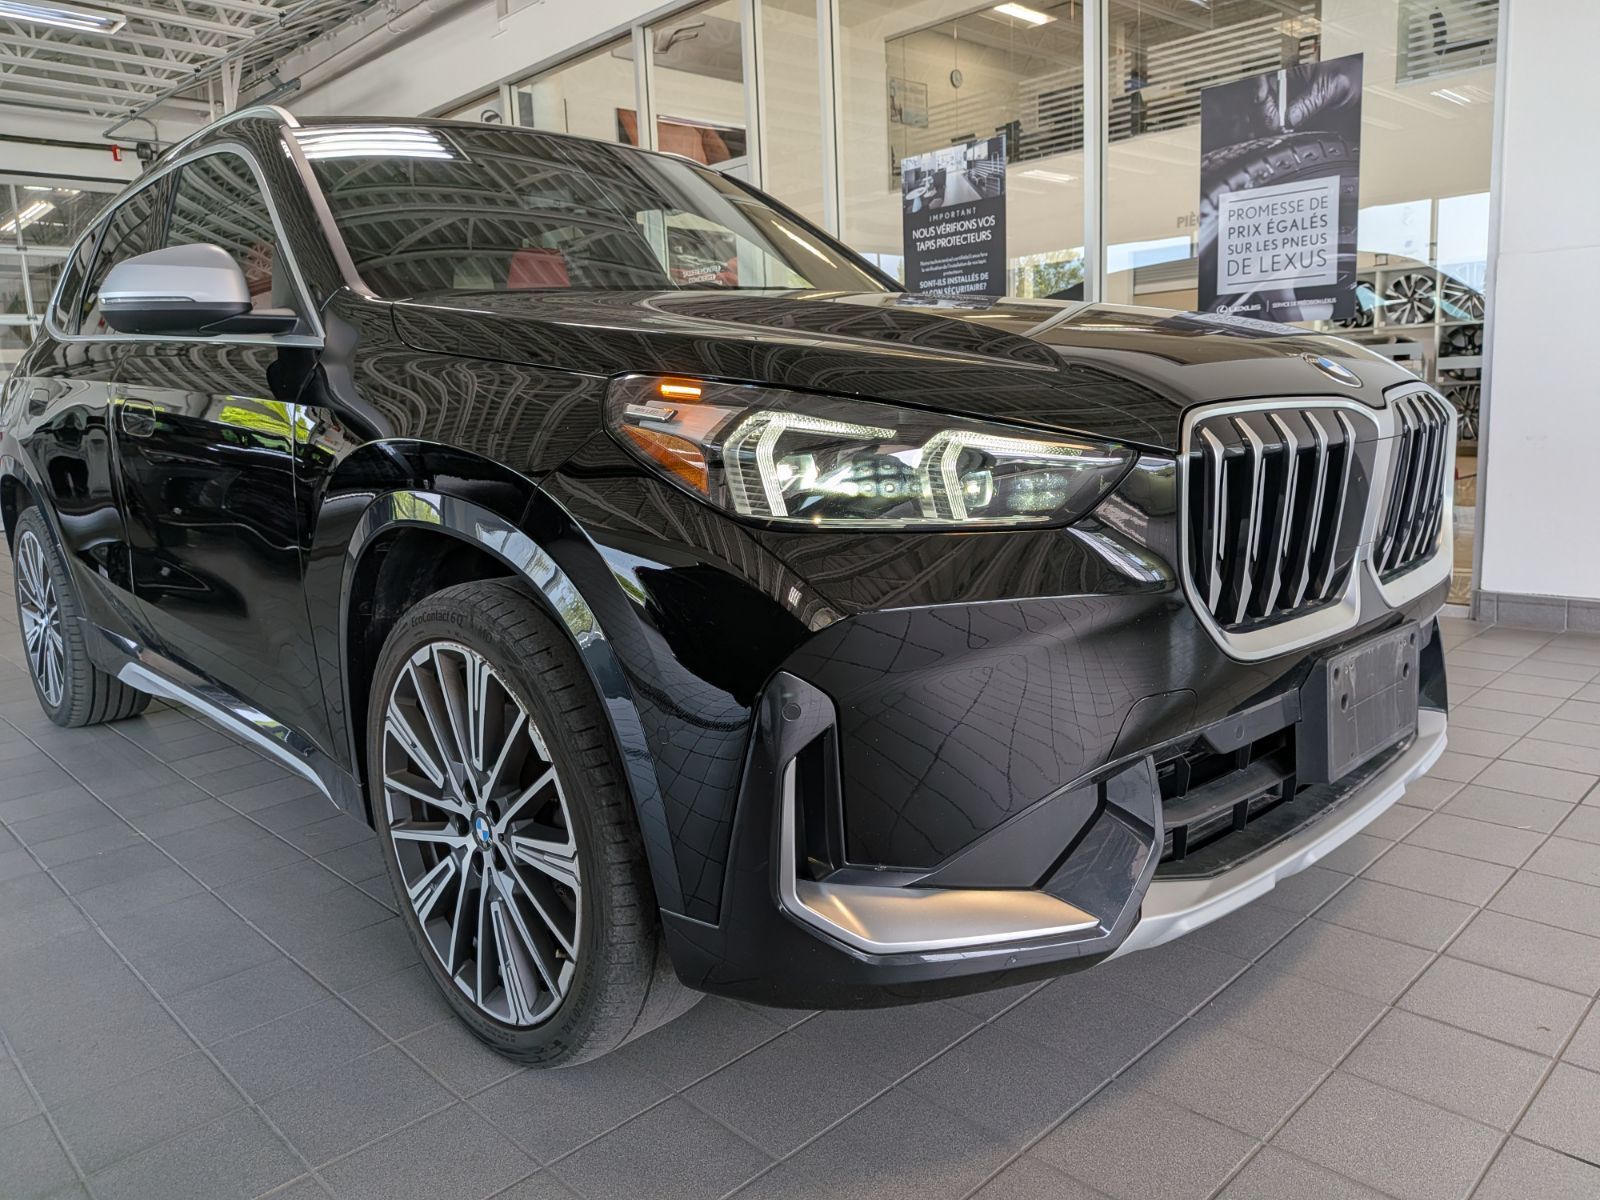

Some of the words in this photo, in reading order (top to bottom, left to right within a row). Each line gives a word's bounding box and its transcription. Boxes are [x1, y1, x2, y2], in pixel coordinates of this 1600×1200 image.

[929, 207, 977, 222] IMPORTANT
[1228, 199, 1305, 222] PROMESSE
[1309, 195, 1329, 211] DE
[912, 226, 936, 240] NOUS
[936, 218, 977, 236] VÉRIFIONS
[977, 215, 996, 228] VOS
[1228, 223, 1262, 240] PRIX
[1266, 212, 1328, 235] ÉGALÉS
[916, 239, 936, 252] TAPIS
[936, 230, 992, 249] PROTECTEURS
[1227, 242, 1252, 256] SUR
[1256, 239, 1279, 253] LES
[1282, 233, 1328, 250] PNEUS
[1227, 257, 1252, 277] DE
[1259, 249, 1327, 274] LEXUS
[919, 278, 947, 289] SONT-ILS
[946, 272, 980, 285] INSTALLÉS
[979, 272, 990, 281] DE
[943, 282, 988, 296] SÉCURITAIRE?
[1229, 303, 1262, 314] LEXUS
[411, 610, 450, 627] EcoContact
